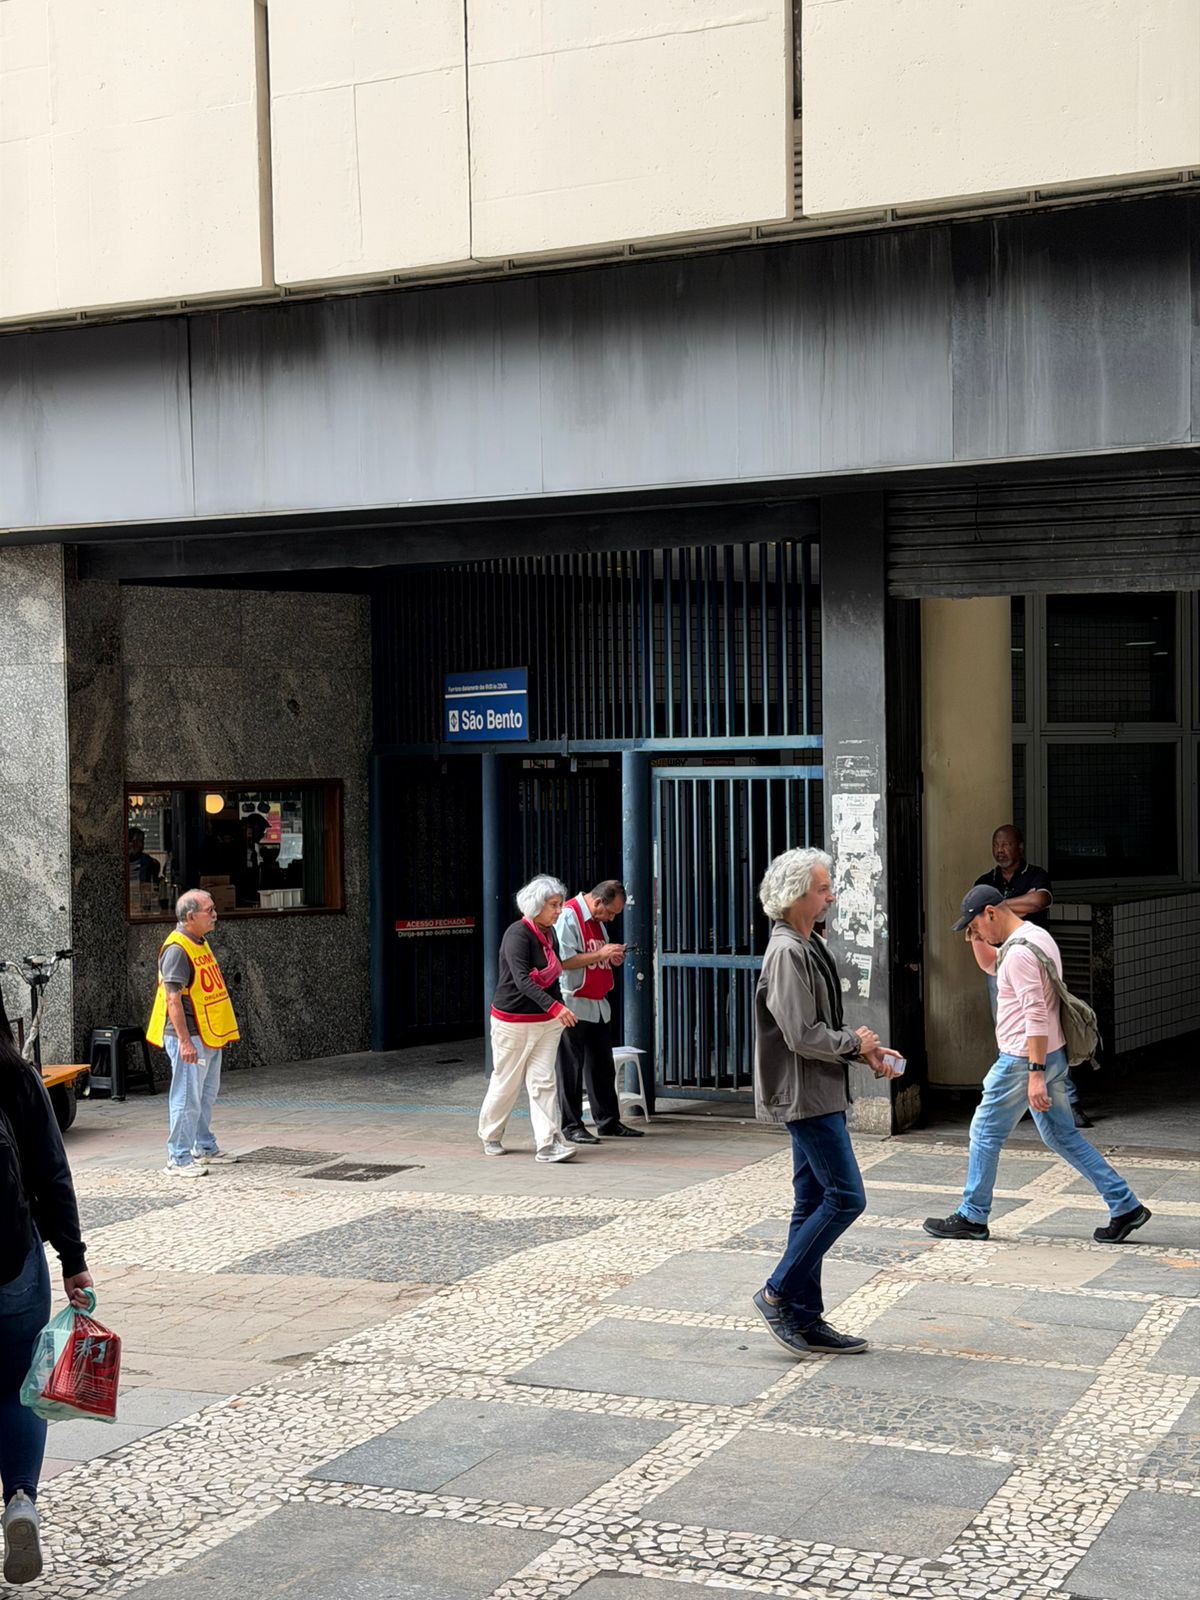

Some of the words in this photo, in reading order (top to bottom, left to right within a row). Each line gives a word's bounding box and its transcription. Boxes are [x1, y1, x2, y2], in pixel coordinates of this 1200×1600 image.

[461, 710, 484, 730] São
[486, 709, 523, 729] Bento
[648, 759, 688, 767] SUBWAY
[406, 920, 434, 928] ACESSO
[435, 918, 466, 926] FECHADO
